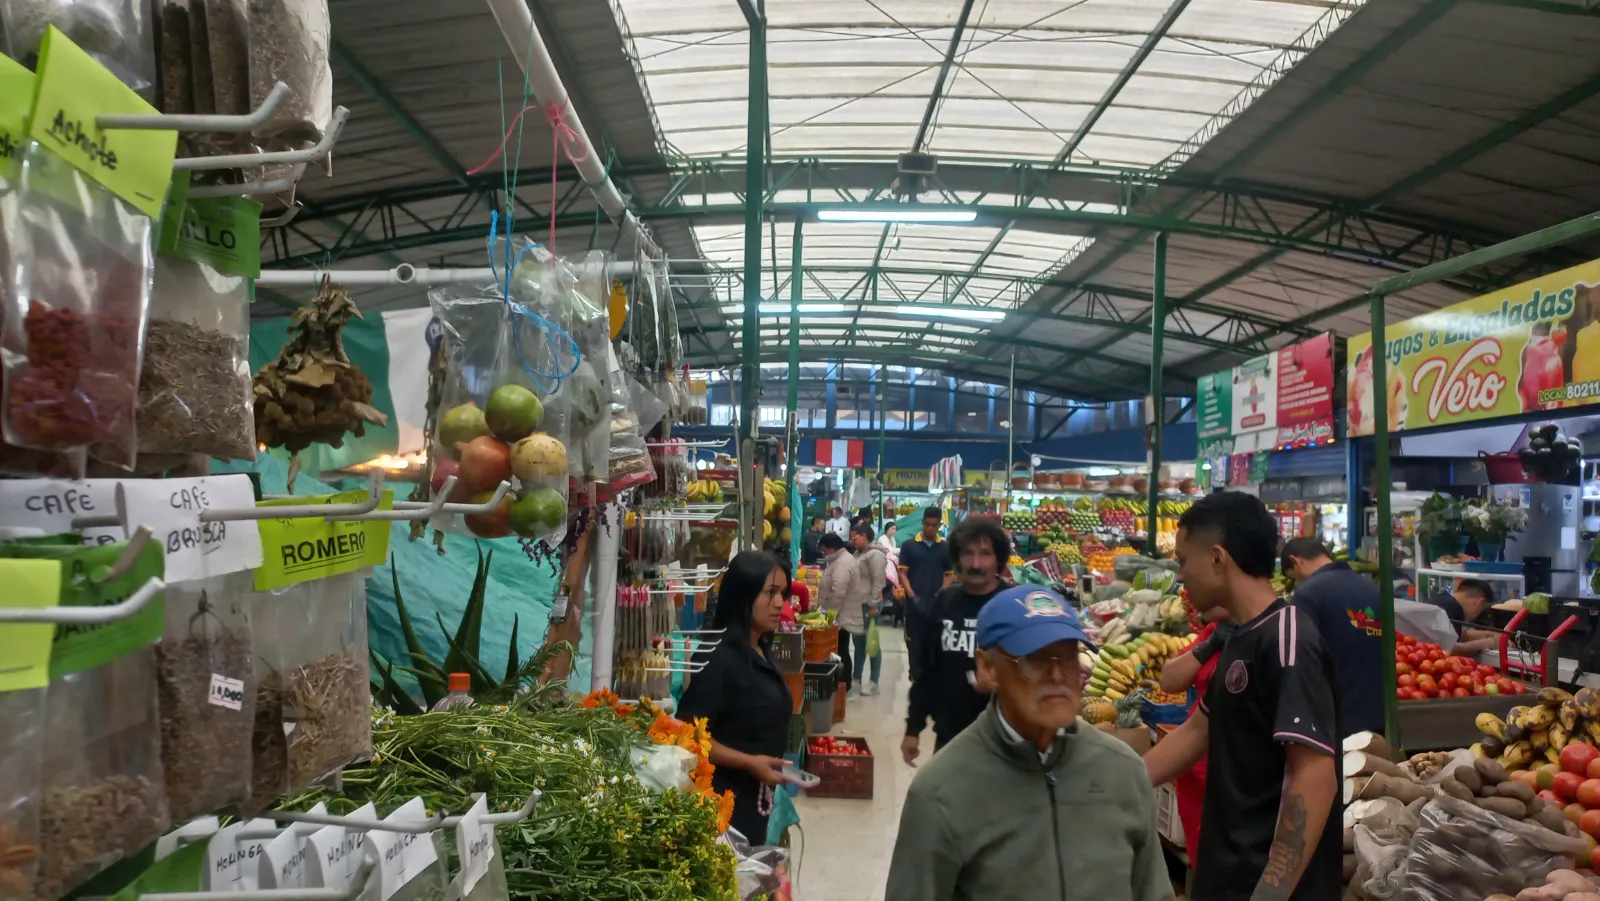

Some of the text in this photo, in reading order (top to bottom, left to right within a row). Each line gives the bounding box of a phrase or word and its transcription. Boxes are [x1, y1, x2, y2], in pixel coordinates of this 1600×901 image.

[1429, 329, 1438, 347] &
[1444, 288, 1575, 345] Ensaladas
[1539, 387, 1565, 402] LOCAL
[281, 531, 365, 566] ROMERO
[941, 619, 978, 658] BEAT
